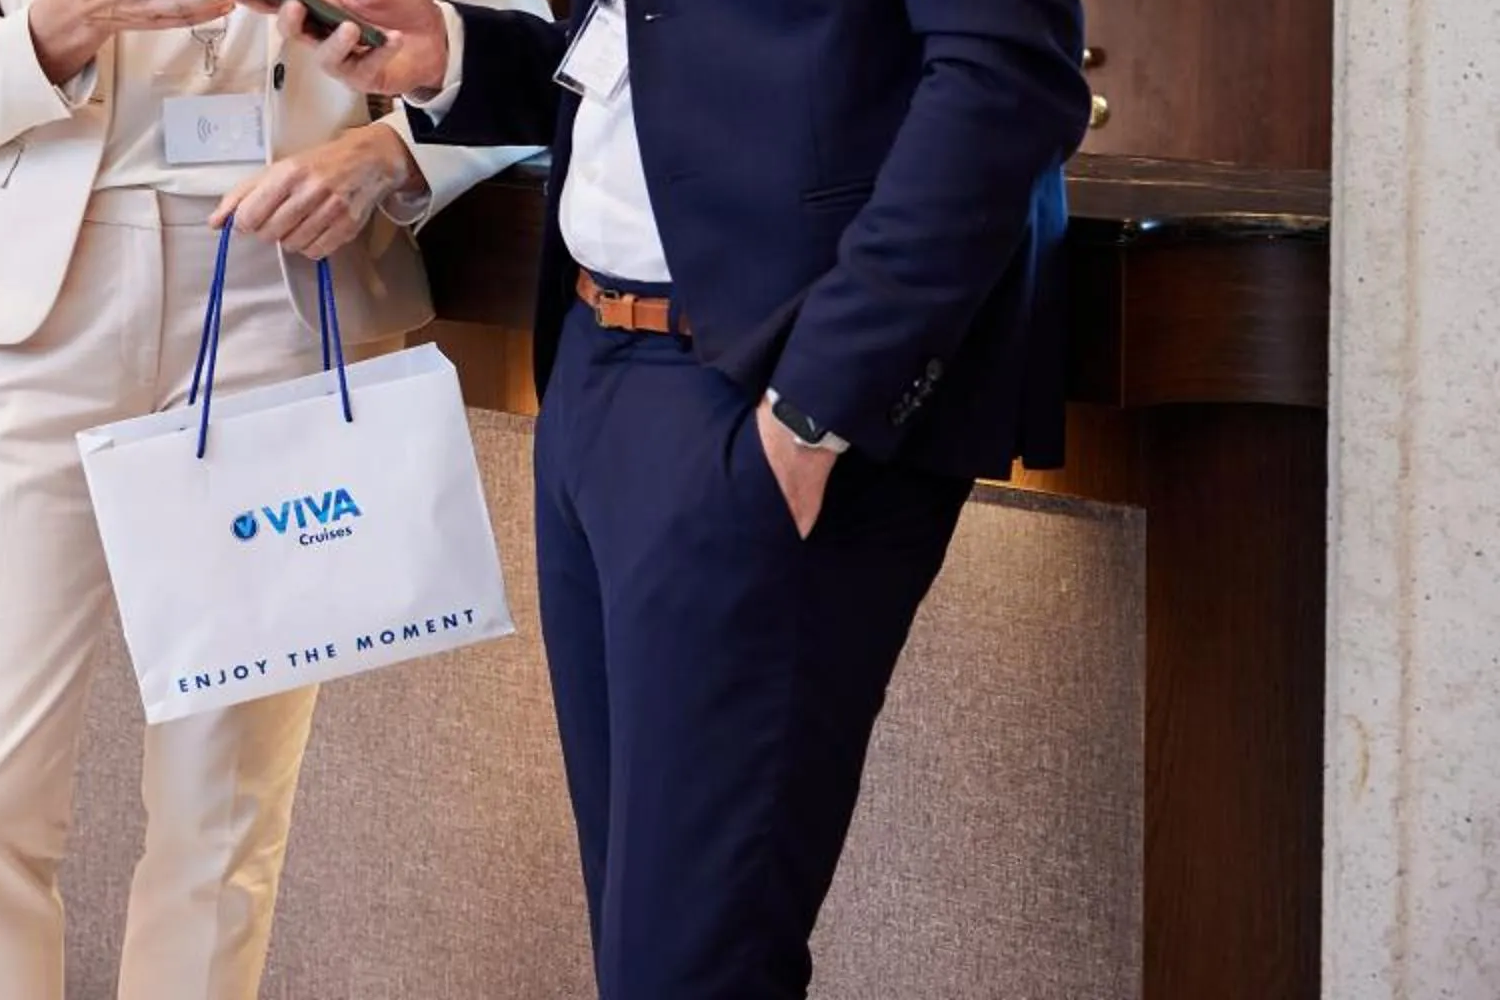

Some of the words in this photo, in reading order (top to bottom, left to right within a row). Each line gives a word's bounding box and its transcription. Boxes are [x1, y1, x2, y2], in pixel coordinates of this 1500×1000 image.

[261, 487, 362, 534] VIVA
[299, 525, 353, 546] Cruises
[178, 659, 267, 693] ENJOY
[288, 643, 337, 668] THE
[356, 608, 475, 651] MOMENT
